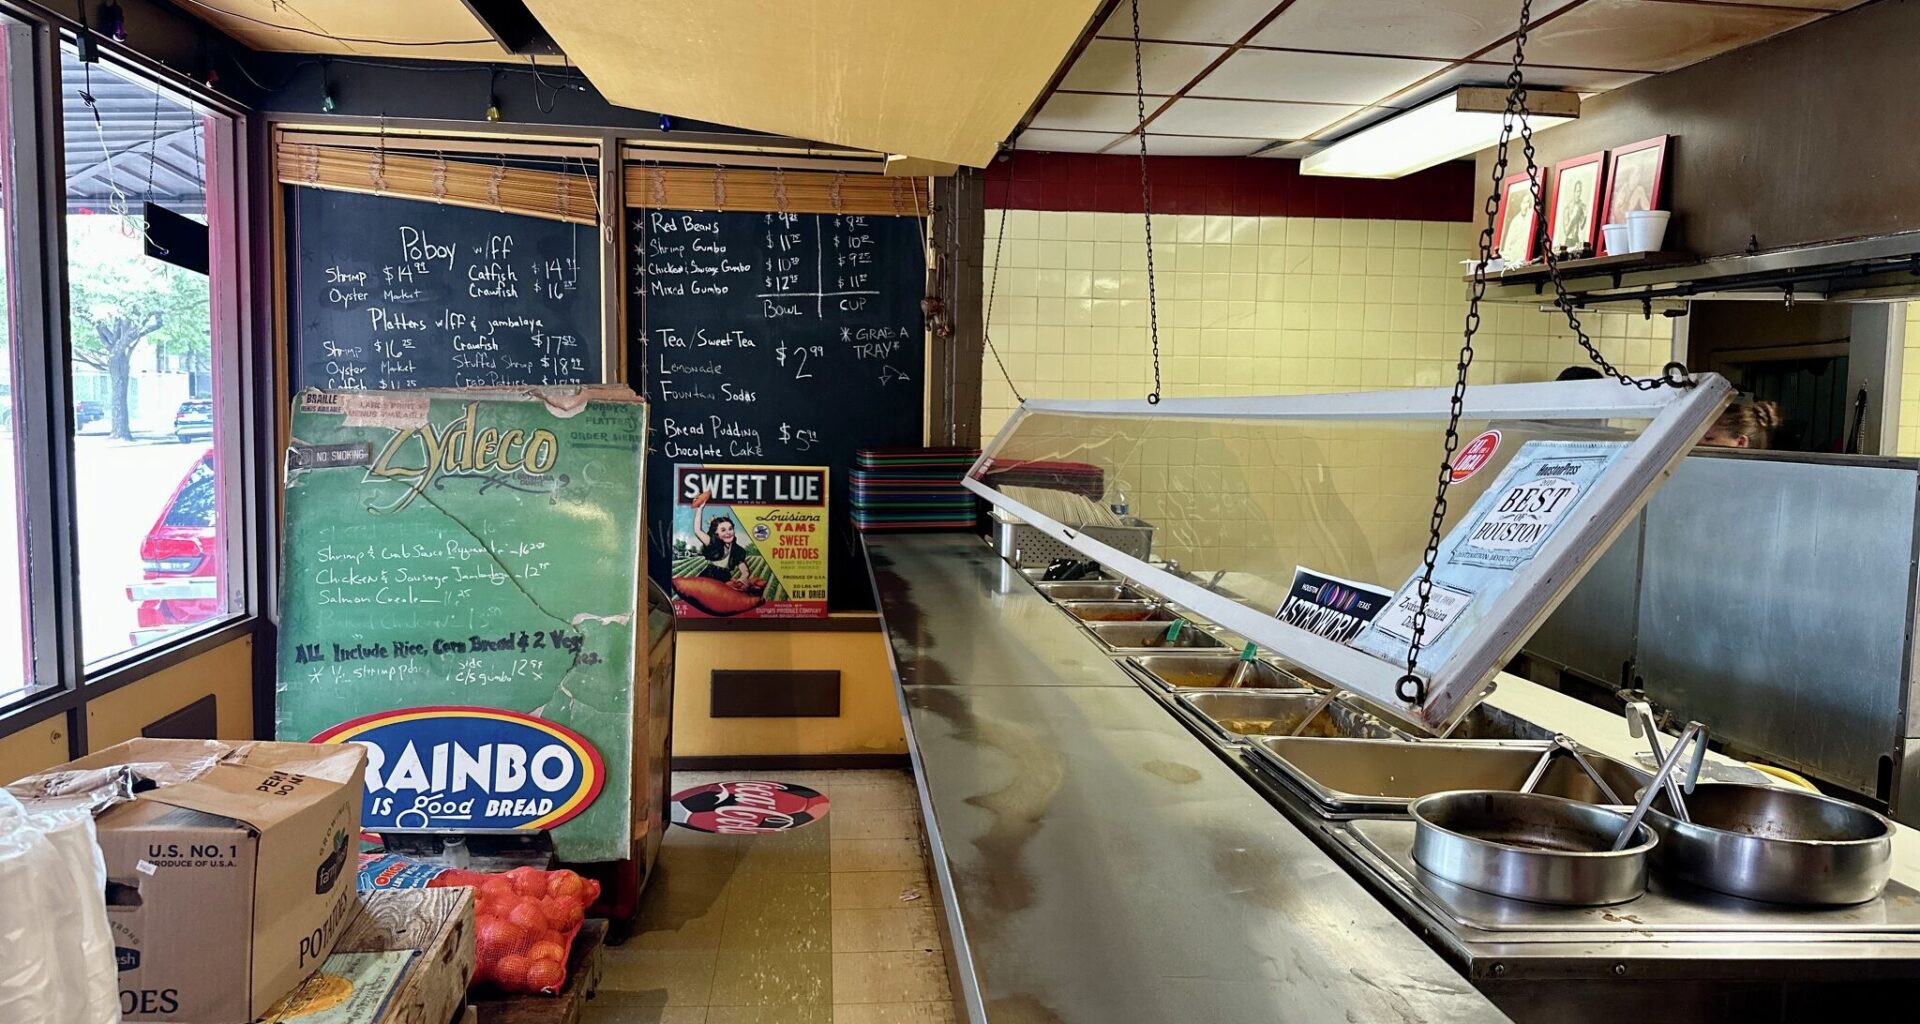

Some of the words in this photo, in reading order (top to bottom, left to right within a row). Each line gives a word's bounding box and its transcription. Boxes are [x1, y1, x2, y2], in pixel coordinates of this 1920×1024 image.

[651, 212, 678, 234] Red
[682, 215, 720, 234] Beans
[650, 237, 685, 258] Shrimp
[692, 238, 727, 254] Gumbo
[325, 266, 367, 287] Shrimp
[468, 263, 518, 281] Catfish
[648, 262, 684, 275] Chicken
[690, 260, 719, 276] Sausage
[721, 259, 751, 273] Gumbo
[469, 281, 519, 298] Crawfish
[651, 280, 684, 296] Mixed
[691, 280, 729, 295] Gumbo
[329, 288, 369, 309] Oyster
[383, 289, 424, 302] Market
[840, 299, 867, 311] CUP
[367, 307, 427, 331] Platters
[488, 316, 544, 335] jambalaya
[855, 327, 896, 341] GRAB
[900, 326, 910, 338] A
[323, 340, 362, 358] Shrimp
[453, 335, 499, 351] Crawfish
[452, 352, 497, 369] Stuffed
[660, 353, 723, 375] Lemonade
[326, 361, 367, 380] Oyster
[381, 360, 417, 378] Market
[306, 394, 338, 405] BRAILLE
[660, 380, 716, 402] Fountain
[721, 383, 757, 402] Sodas
[570, 432, 608, 441] ORDER
[664, 418, 704, 439] Bread
[709, 415, 761, 447] Pudding
[316, 452, 327, 461] NO
[331, 449, 364, 461] SMOKING
[362, 400, 558, 515] Zydeco
[664, 441, 723, 459] Chocolate
[729, 440, 764, 458] Cake
[684, 473, 767, 500] SWEET
[775, 475, 819, 501] LUE
[1498, 487, 1571, 513] BEST
[755, 509, 821, 522] Louisiana
[1513, 513, 1528, 522] OF
[774, 522, 816, 532] YAMS
[1473, 522, 1549, 543] HOUSTON
[779, 535, 809, 546] SWEET
[317, 544, 364, 564] Shrimp
[382, 544, 411, 559] Crab
[772, 547, 819, 559] POTATOES
[316, 567, 378, 585] Chicken
[395, 568, 449, 589] Sausage
[318, 587, 371, 605] Salmon
[376, 585, 418, 604] Creole
[792, 590, 806, 599] KILN
[809, 590, 826, 599] DRIED
[1356, 600, 1372, 611] TEXAS
[295, 642, 325, 664] ALL
[333, 642, 389, 662] Include
[392, 640, 429, 658] Rice,
[433, 638, 467, 655] Corn
[468, 632, 516, 653] Bread
[533, 631, 546, 649] 2
[353, 664, 396, 681] shrimp
[349, 739, 574, 795] RAINBO
[371, 797, 394, 816] IS
[396, 792, 476, 829] good
[485, 798, 553, 817] BREAD
[149, 845, 184, 858] U.S.
[190, 845, 224, 858] NO.
[229, 845, 237, 858] 1
[210, 860, 237, 868] U.S.A.
